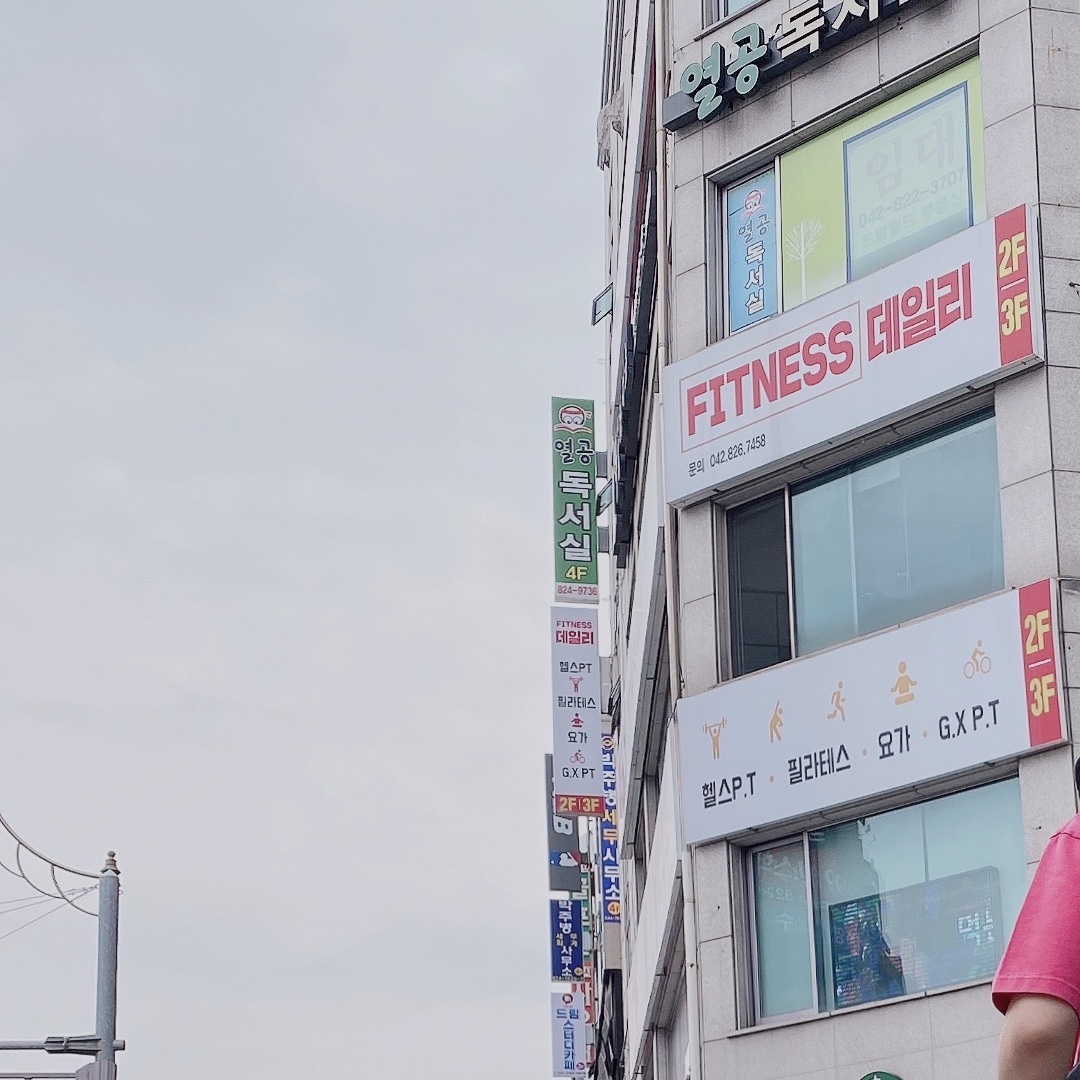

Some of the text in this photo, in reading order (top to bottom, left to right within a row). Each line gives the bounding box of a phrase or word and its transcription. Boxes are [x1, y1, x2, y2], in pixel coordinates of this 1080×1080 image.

[680, 23, 767, 120] 열공
[859, 165, 965, 228] 042-822-3707
[736, 212, 771, 318] 열공 독서실
[998, 233, 1026, 279] 2F
[1001, 293, 1030, 336] 3F
[686, 261, 973, 437] FITNESS 데일리
[687, 457, 705, 478] 문의
[553, 438, 595, 562] 열공 독서실
[556, 585, 598, 597] 824-9736
[565, 565, 588, 582] 4F
[555, 629, 595, 646] 데일리
[556, 620, 592, 630] FITNESS
[1024, 609, 1051, 655] 2F
[559, 660, 593, 674] 헬스PT
[558, 695, 597, 709] 필라테스
[1028, 674, 1056, 718] 3F
[567, 731, 588, 744] 요가
[787, 745, 851, 786] 필라테스
[877, 725, 911, 760] 요가
[559, 796, 600, 812] 2F 3F
[556, 1008, 579, 1020] 드림
[563, 1020, 575, 1070] 스터디카페
